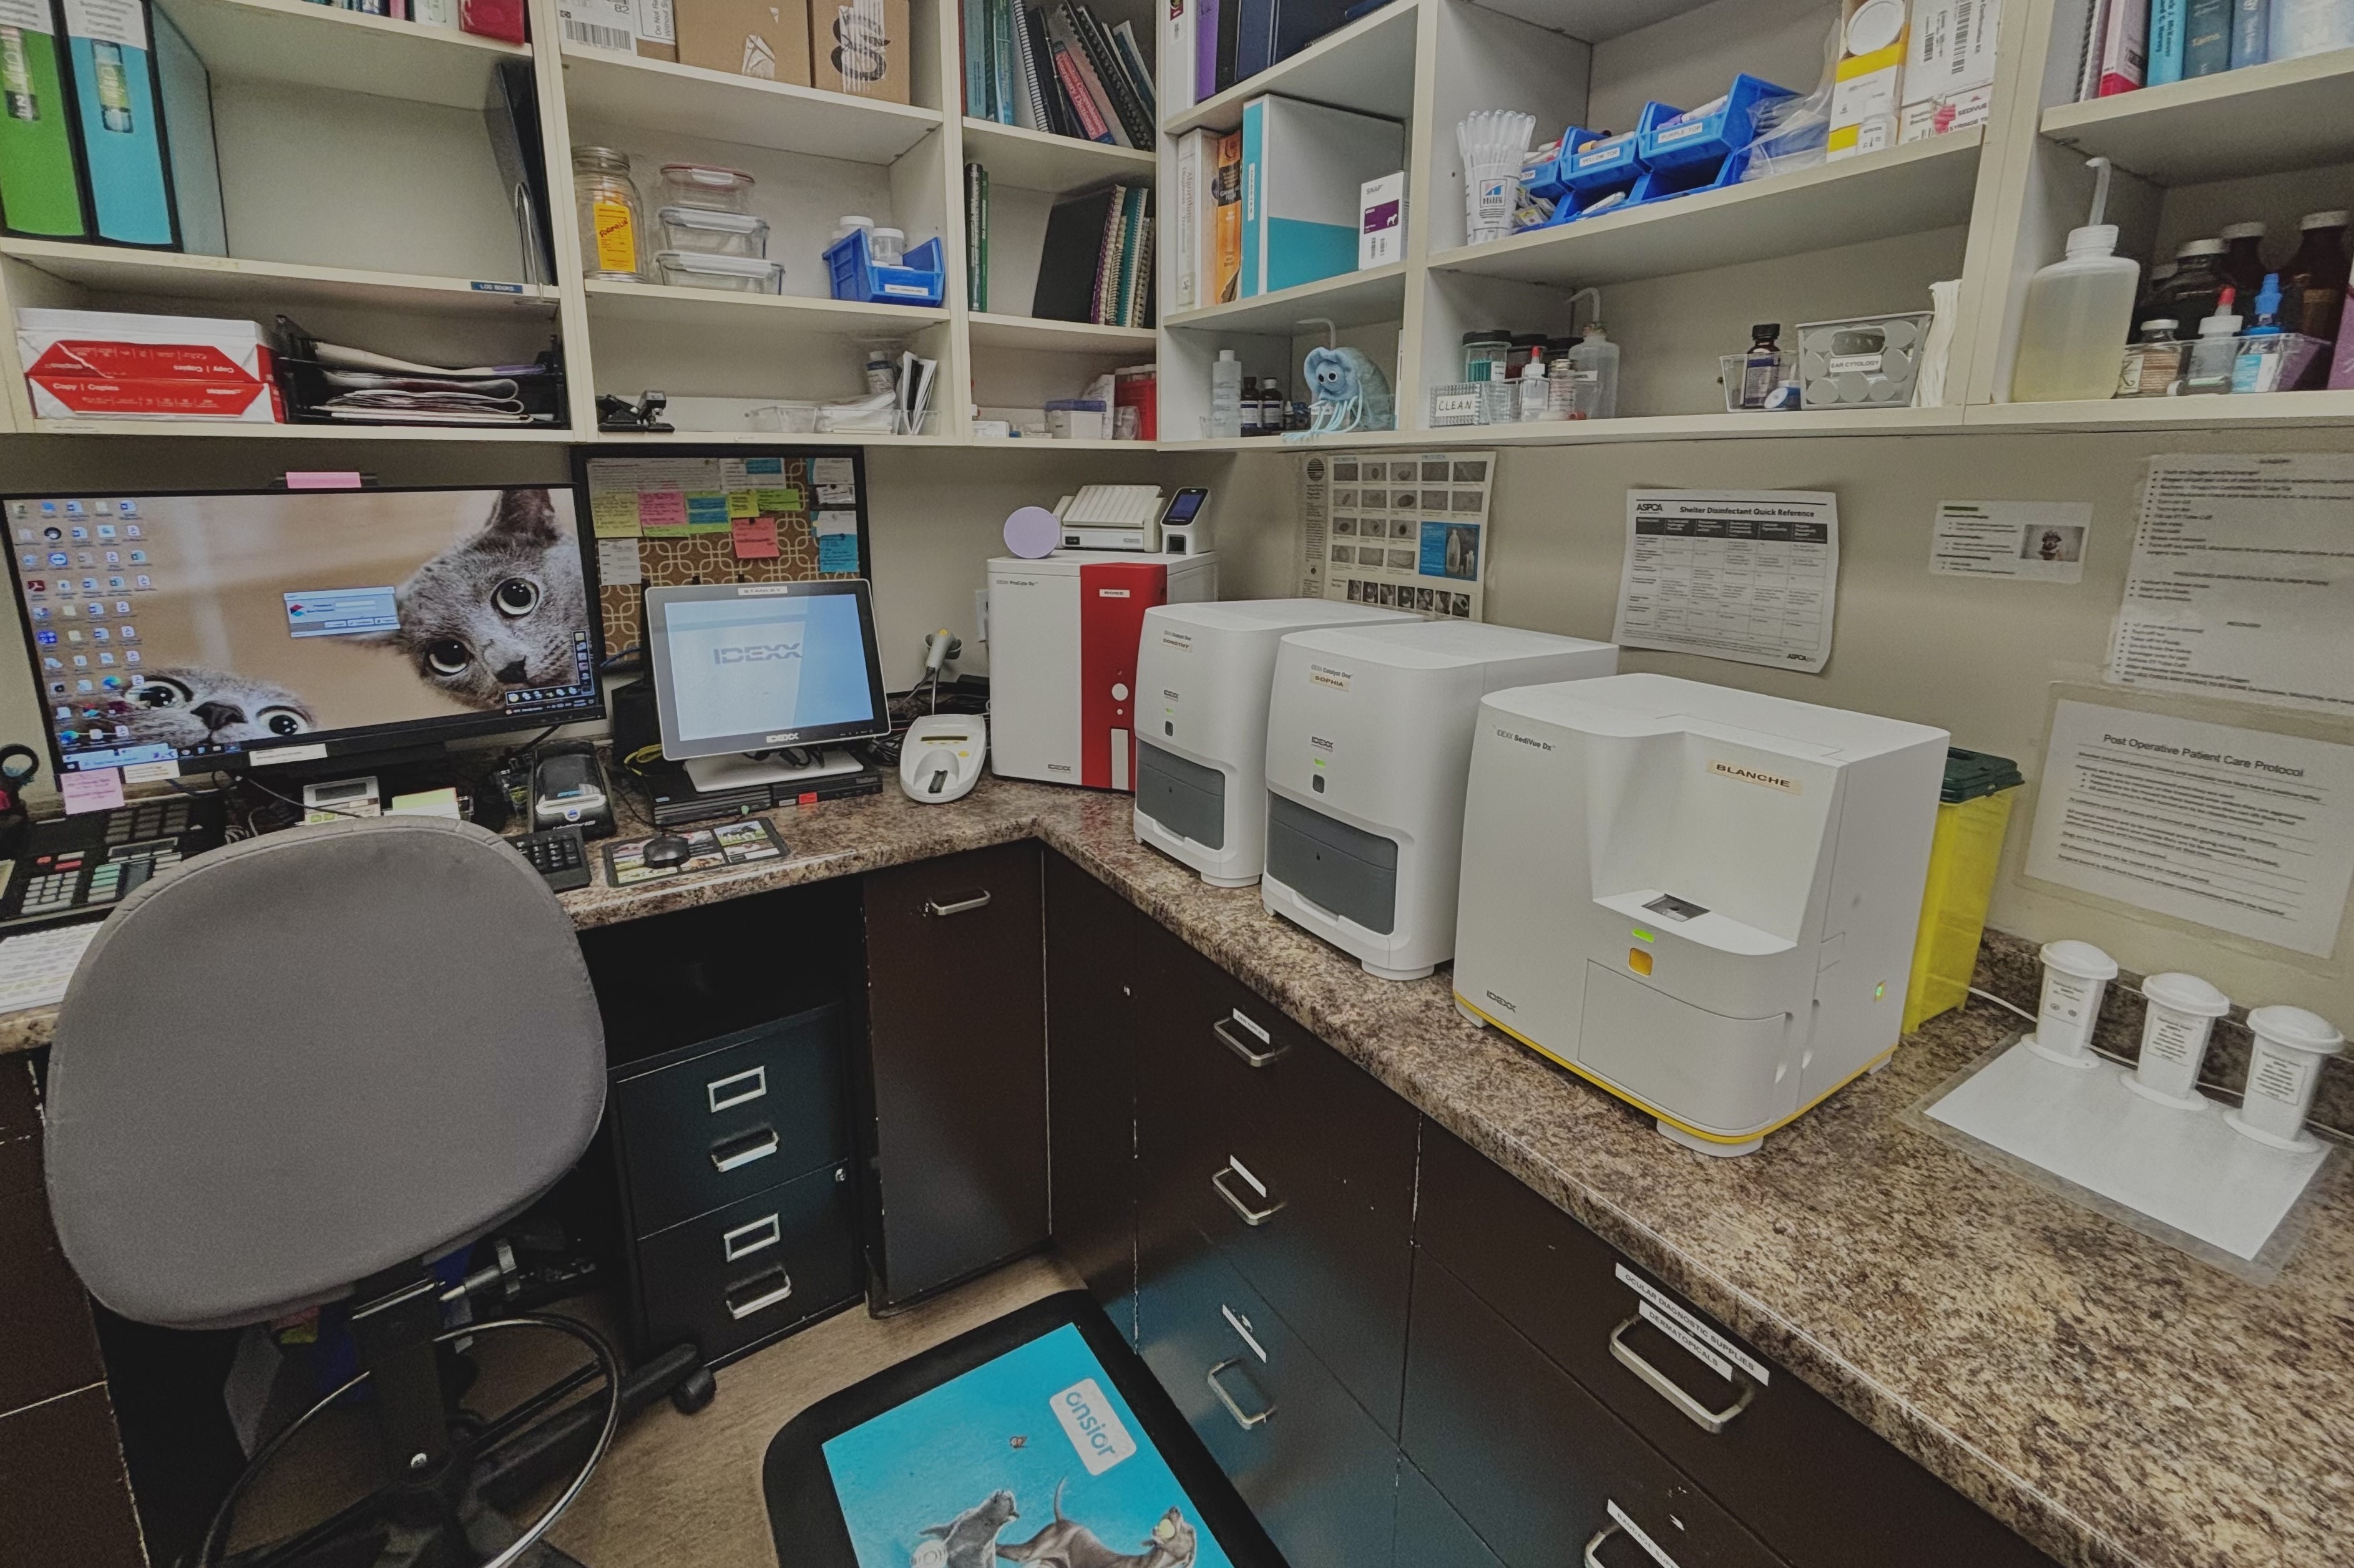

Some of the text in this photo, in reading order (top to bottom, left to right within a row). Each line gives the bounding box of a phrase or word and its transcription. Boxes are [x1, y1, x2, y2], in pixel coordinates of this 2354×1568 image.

[1661, 125, 1702, 140] PURPLE TOP
[1582, 150, 1619, 164] YELLOW TOP
[1845, 360, 1880, 368] CYTOLOGY
[52, 382, 77, 391] Copy
[1438, 400, 1473, 411] CLEAN
[1636, 504, 1663, 512] ASPCA
[1754, 508, 1776, 516] Quick
[1777, 509, 1815, 517] Reference
[1163, 638, 1189, 649] DOROTHY
[713, 643, 803, 665] IDEXX
[1314, 675, 1344, 687] SOPHIA
[1513, 734, 1541, 749] SediVue
[2103, 734, 2305, 777] Post Operative Patient Care Protocol
[1716, 763, 1791, 788] BLANCHE
[1625, 1274, 1755, 1371] OCULAR DIAGNOSTIC SUPPLIES
[1649, 1311, 1718, 1366] DERMATOPICALS
[1065, 1391, 1117, 1459] onsior
